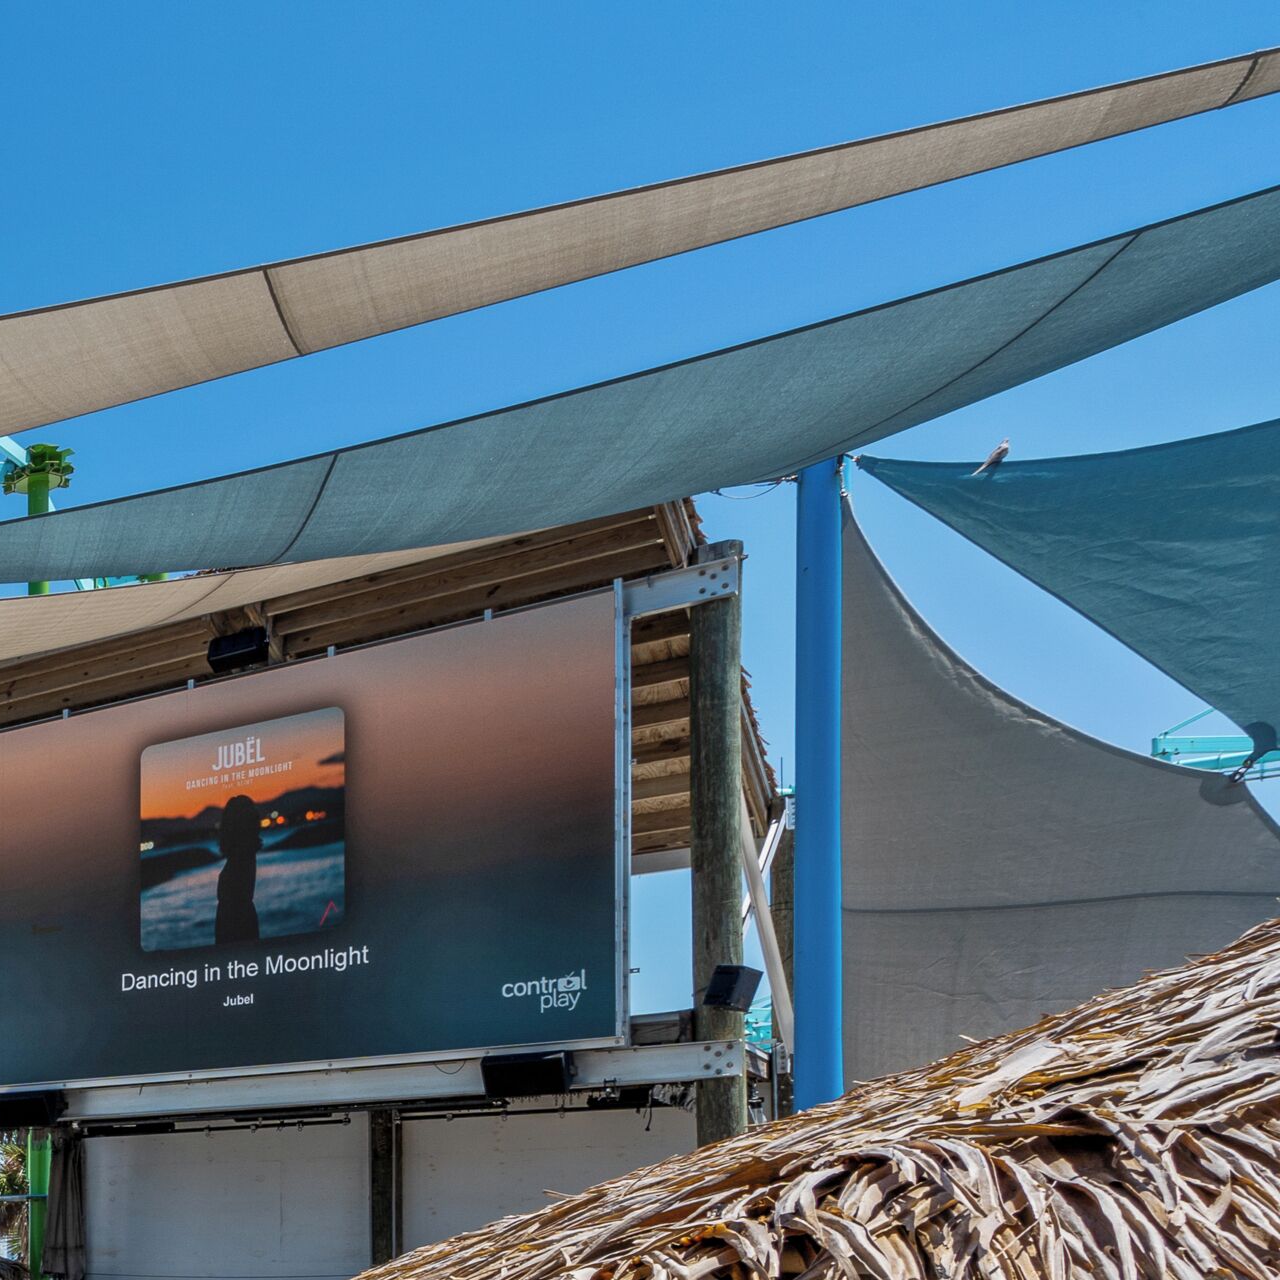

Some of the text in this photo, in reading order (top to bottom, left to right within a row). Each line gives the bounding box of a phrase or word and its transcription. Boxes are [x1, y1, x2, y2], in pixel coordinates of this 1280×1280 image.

[212, 736, 266, 771] JUBËL
[186, 775, 219, 790] DANCING
[220, 774, 229, 784] IN
[232, 771, 246, 780] THE
[248, 761, 293, 777] MOONLIGHT
[121, 945, 370, 992] Dancing in the Moonlight
[223, 993, 254, 1007] Jubel
[540, 987, 581, 1014] play
